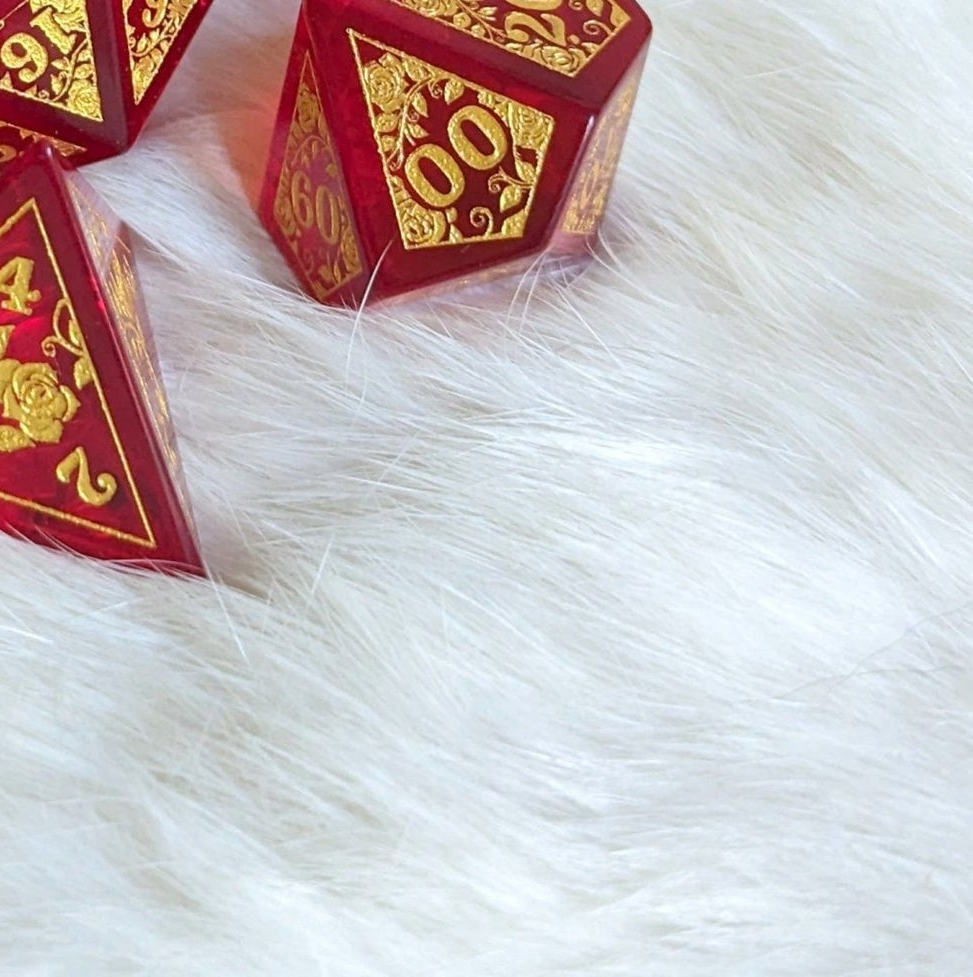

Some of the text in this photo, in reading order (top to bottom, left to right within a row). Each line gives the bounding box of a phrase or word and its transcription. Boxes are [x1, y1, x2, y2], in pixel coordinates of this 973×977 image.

[403, 104, 508, 208] 00
[291, 169, 340, 244] 60
[55, 446, 118, 507] 2
